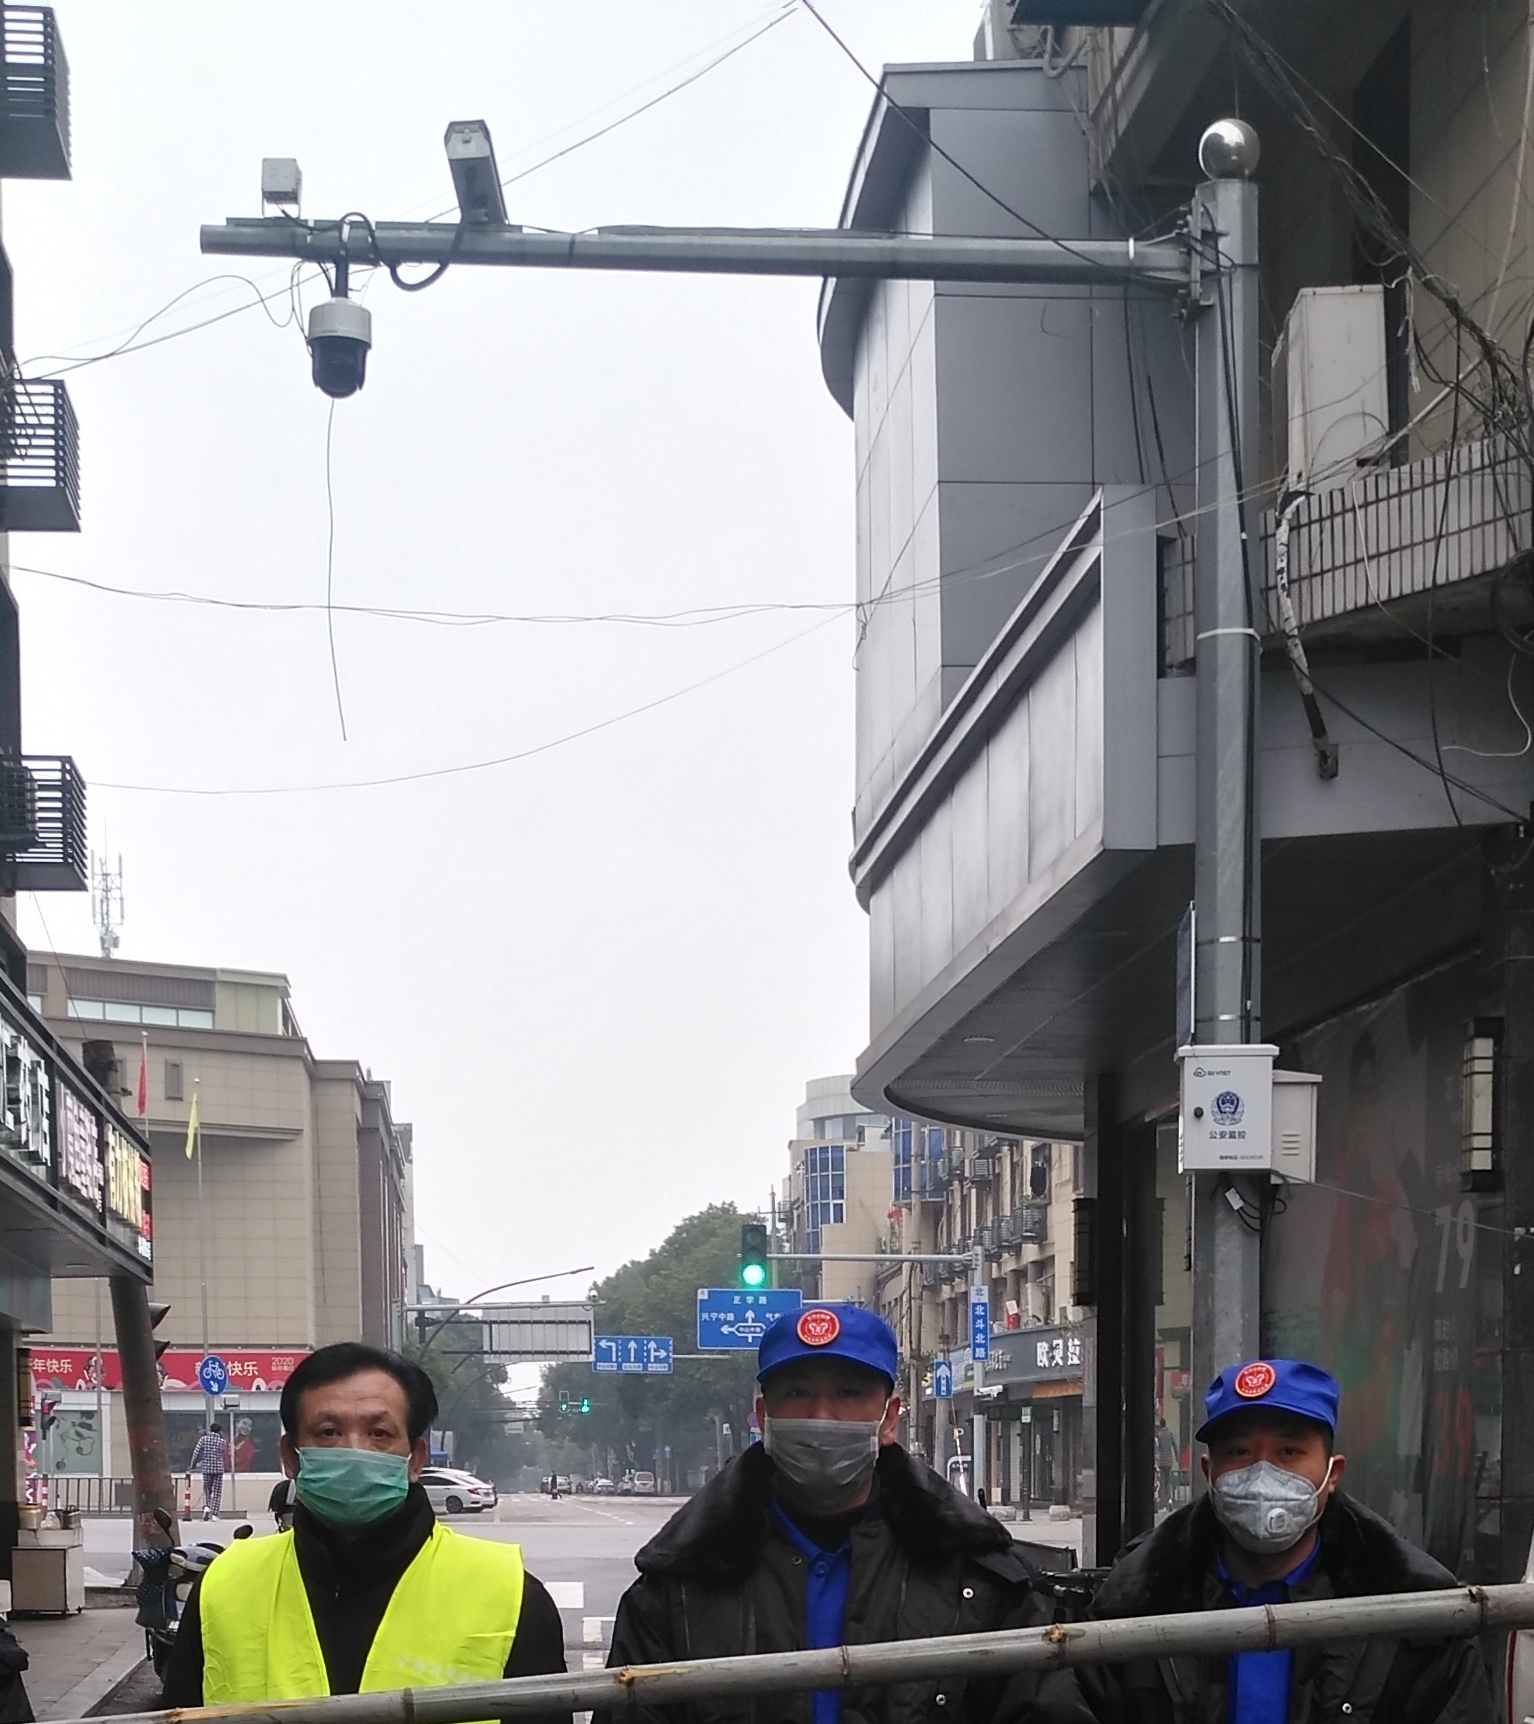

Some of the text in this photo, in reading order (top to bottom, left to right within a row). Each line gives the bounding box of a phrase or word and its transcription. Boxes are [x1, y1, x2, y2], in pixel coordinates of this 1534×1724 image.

[1209, 1130, 1247, 1140] 公安监控
[732, 1295, 769, 1305] 正学路
[701, 1312, 736, 1322] 兴宁中路
[974, 1304, 986, 1359] 北斗北路
[270, 1356, 295, 1366] 2020
